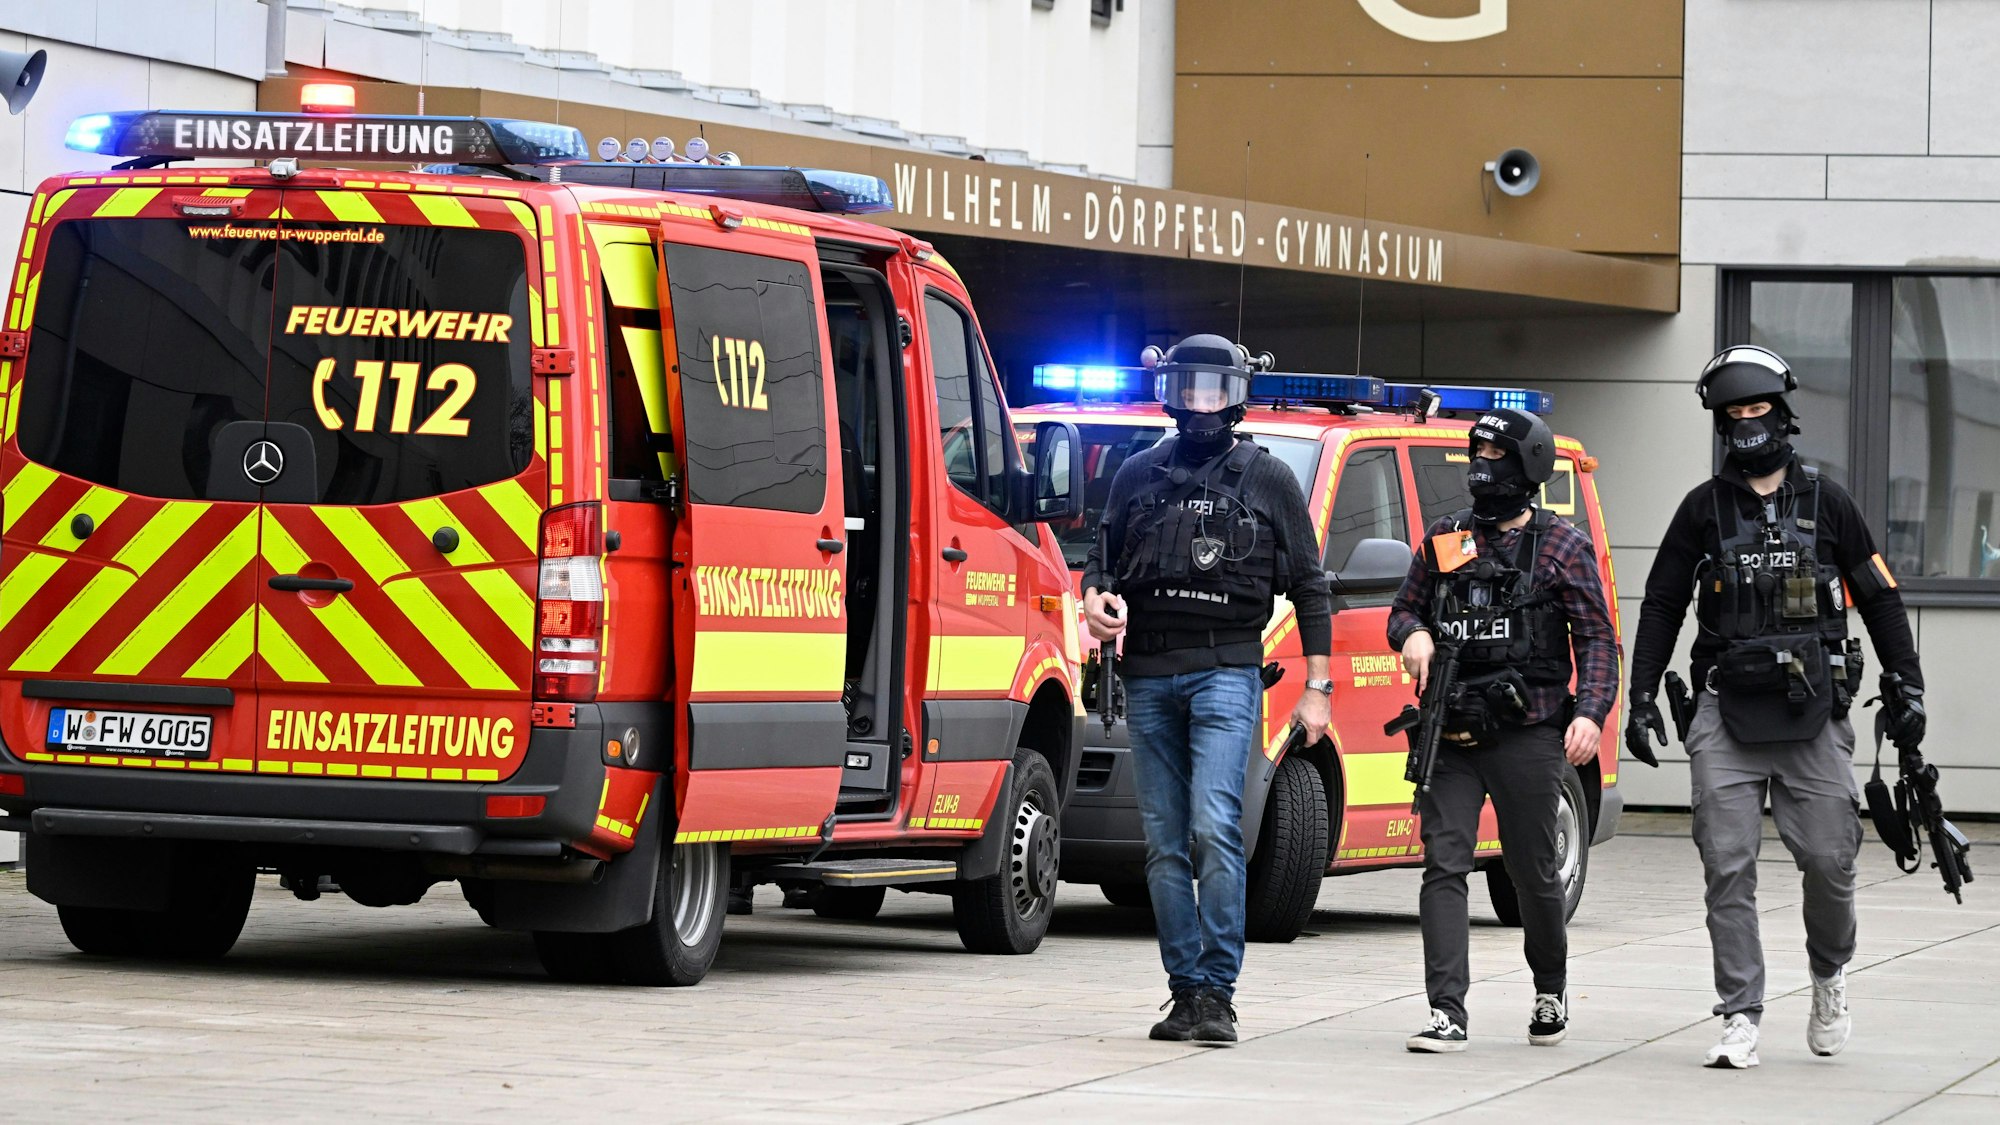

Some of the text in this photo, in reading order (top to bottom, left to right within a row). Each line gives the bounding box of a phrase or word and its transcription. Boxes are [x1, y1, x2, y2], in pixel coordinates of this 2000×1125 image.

[174, 118, 455, 156] EINSATZLEITUNG
[188, 224, 386, 244] www.feuerwehr-wuppertal.de
[893, 162, 1052, 235] WILHELM
[1275, 217, 1443, 283] GYMNASIUM
[285, 305, 513, 343] FEUERWEHR
[722, 337, 768, 411] 112
[353, 359, 478, 437] 112
[1474, 428, 1494, 440] POLIZEI
[1479, 415, 1508, 431] MEK
[696, 565, 841, 618] EINSATZLEITUNG
[965, 571, 1006, 592] FEUERWEHR
[1351, 655, 1397, 673] FEUERWEHR
[67, 714, 83, 741] W
[99, 715, 136, 743] FW
[141, 717, 208, 747] 6005
[266, 709, 515, 759] EINSATZLEITUNG
[933, 794, 960, 814] ELW-B
[1386, 819, 1414, 837] ELW-C
